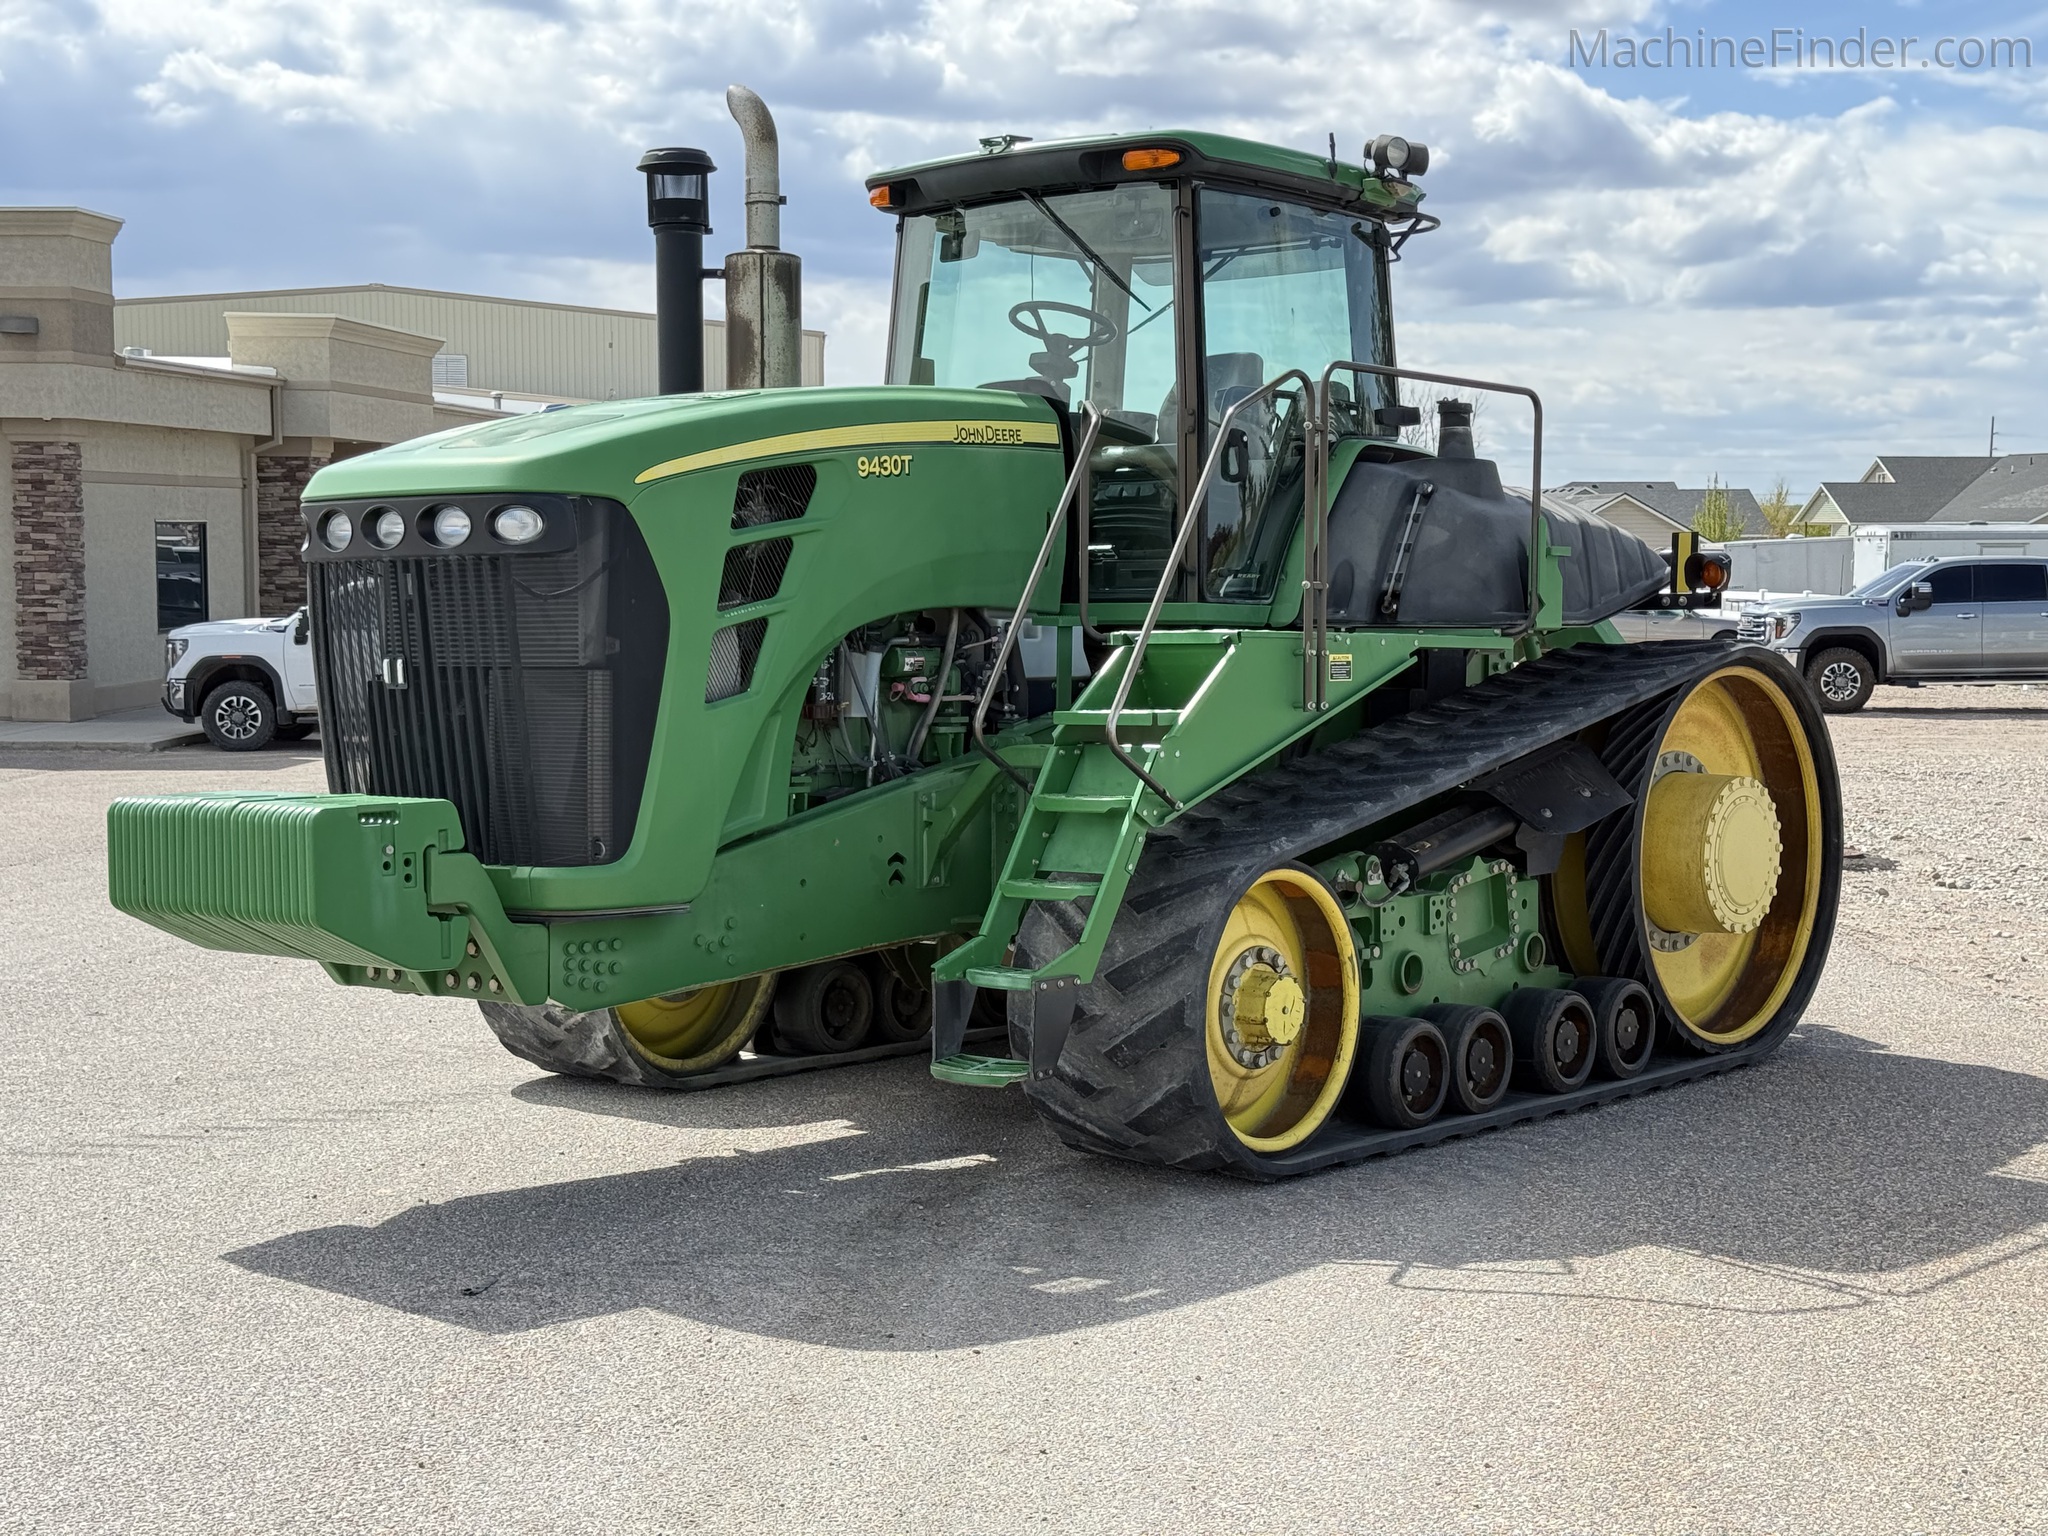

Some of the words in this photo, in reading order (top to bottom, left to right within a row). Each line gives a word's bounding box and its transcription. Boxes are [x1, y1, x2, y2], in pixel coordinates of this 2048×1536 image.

[953, 424, 985, 443] JOHN
[986, 425, 1023, 444] DEERE
[857, 454, 912, 478] 9430T
